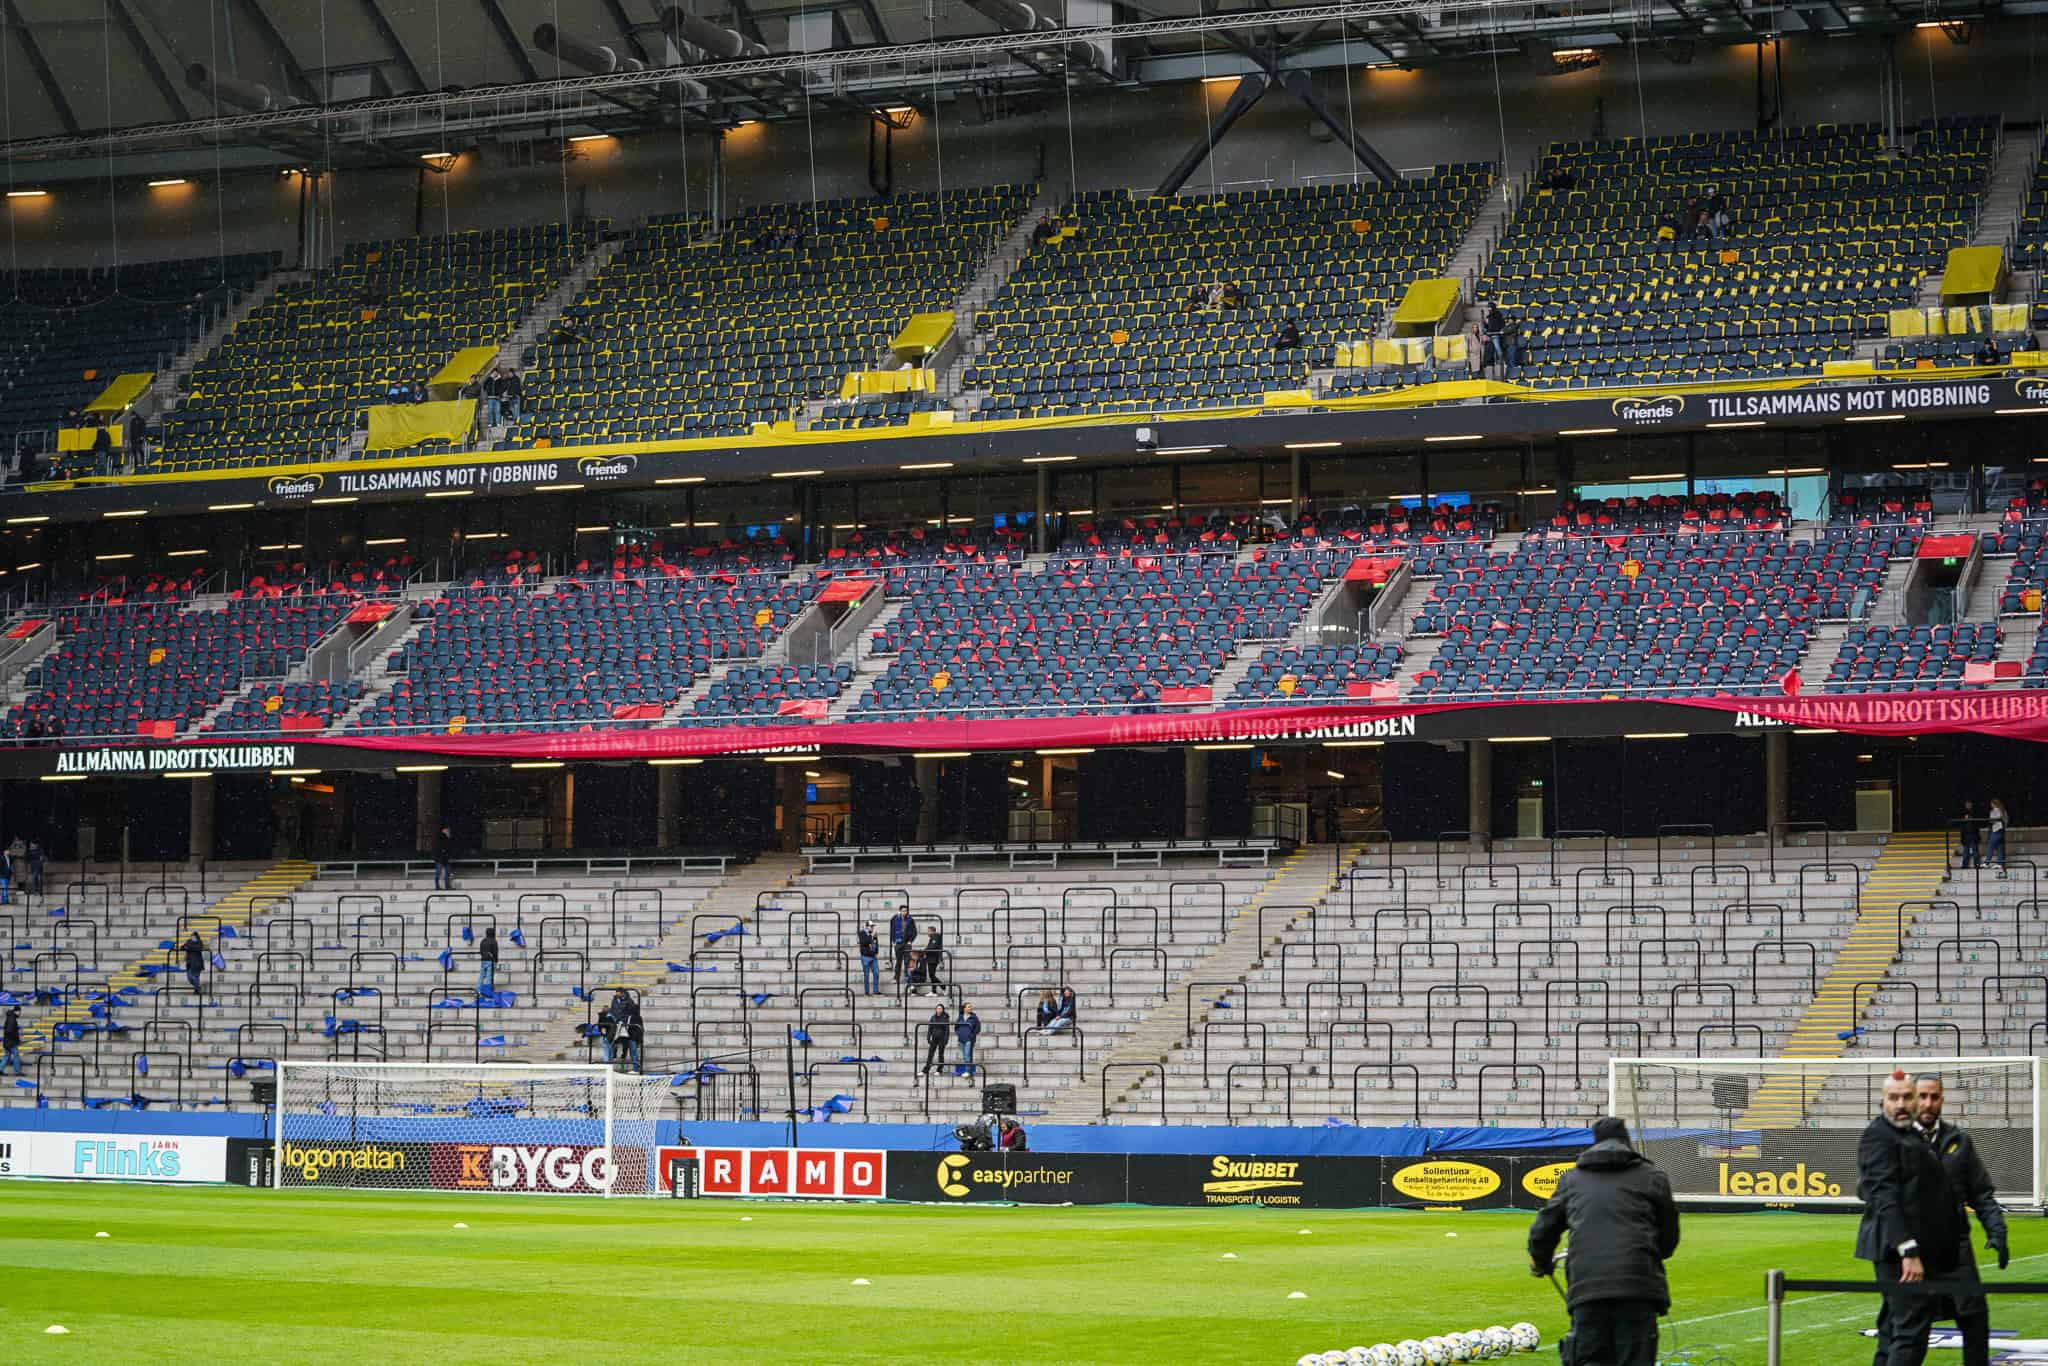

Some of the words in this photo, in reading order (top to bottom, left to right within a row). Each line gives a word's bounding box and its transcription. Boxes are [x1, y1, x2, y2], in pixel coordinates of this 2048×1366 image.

[1623, 402, 1674, 419] friends
[1708, 391, 1840, 417] TILLSAMMANS
[1847, 389, 1886, 411] MOT
[1892, 385, 1990, 408] MOBBNING
[339, 469, 441, 492] TILLSAMMANS
[445, 468, 477, 485] MOT
[585, 461, 628, 476] friends
[276, 480, 315, 494] friends
[1735, 697, 1861, 727] ALLMÄNNA
[56, 748, 145, 772] ALLMÄNNA
[149, 746, 296, 770] IDROTTSKLUBBEN
[74, 1139, 181, 1177] Flinks
[286, 1143, 404, 1180] logomattan
[491, 1146, 618, 1189] BYGG
[668, 1158, 873, 1187] RAMO
[972, 1164, 1073, 1188] easypartner
[1423, 1167, 1470, 1175] Sollentuna
[1206, 1195, 1254, 1205] TRANSPORT
[1264, 1196, 1301, 1205] LOGISTIK
